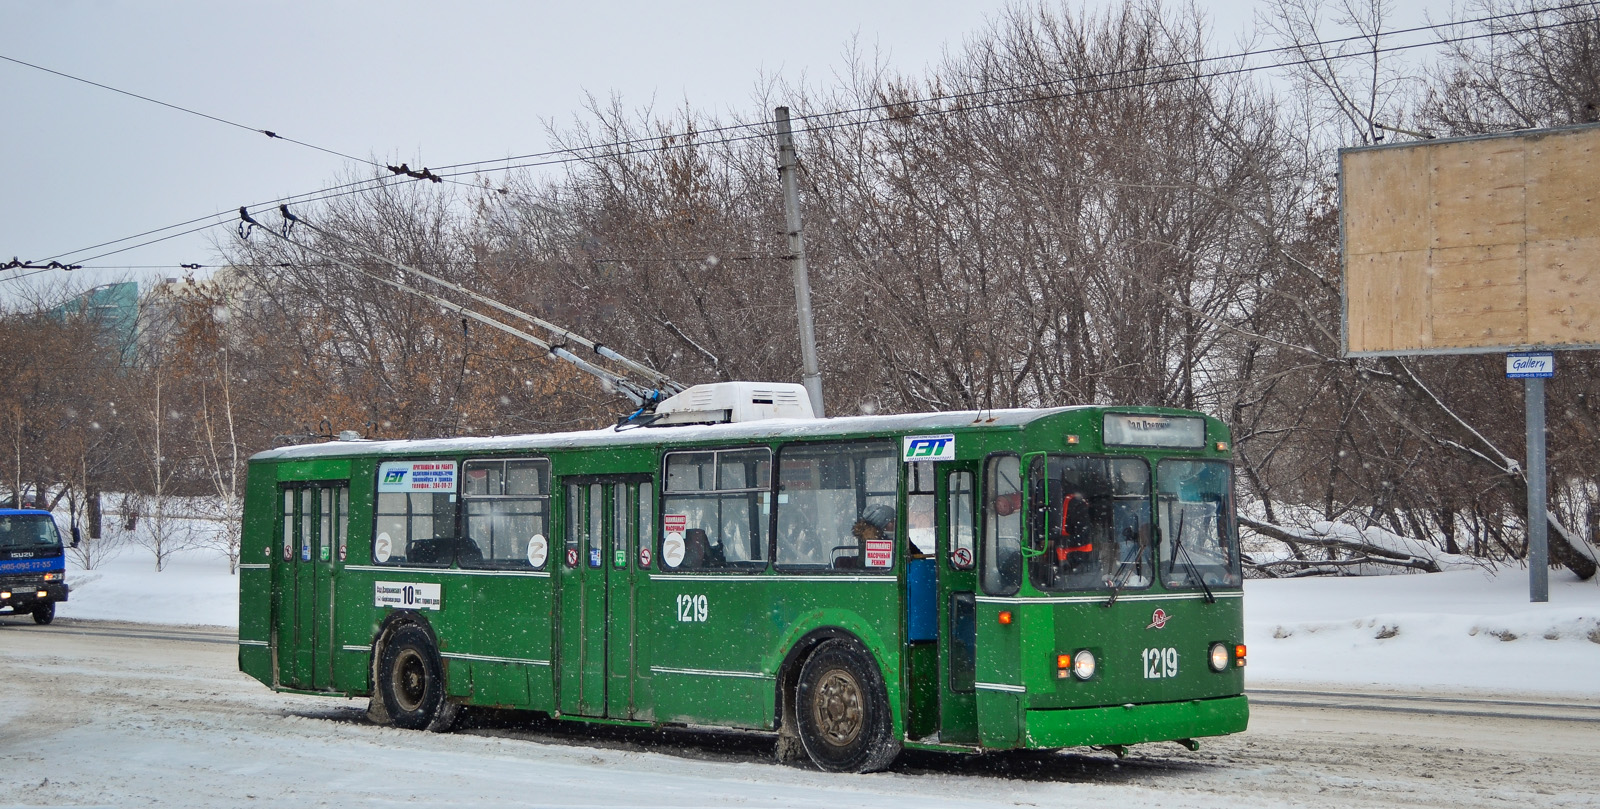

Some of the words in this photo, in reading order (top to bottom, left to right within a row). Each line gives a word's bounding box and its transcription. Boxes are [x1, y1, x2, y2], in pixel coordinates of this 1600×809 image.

[1513, 357, 1545, 371] Gallery
[666, 540, 681, 559] Z
[402, 585, 414, 605] 10
[677, 594, 708, 622] 1219
[1142, 647, 1178, 679] 1219
